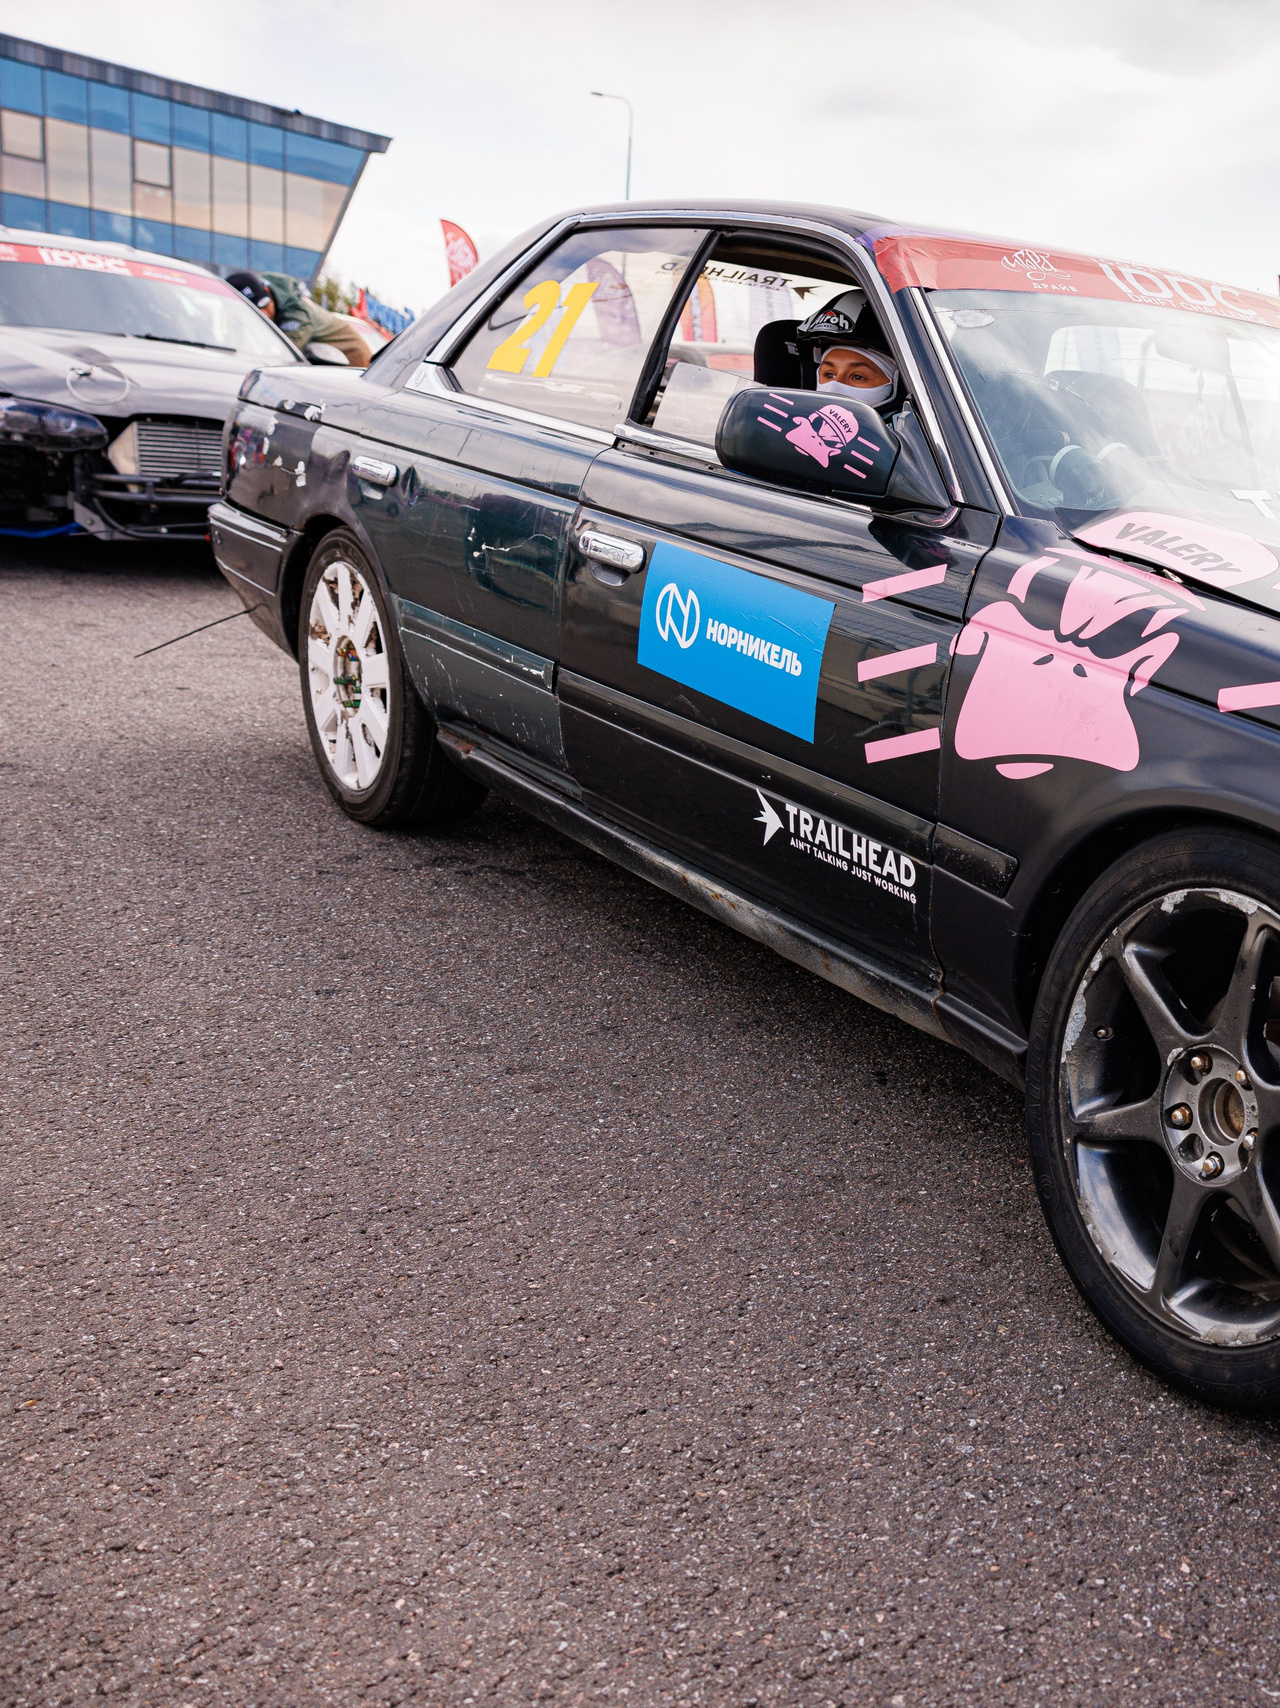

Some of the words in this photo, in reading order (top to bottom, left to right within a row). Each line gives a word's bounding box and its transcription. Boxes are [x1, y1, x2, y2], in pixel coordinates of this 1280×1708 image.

[1032, 282, 1078, 292] ДРАЙВ
[1100, 263, 1258, 316] IDDC
[1128, 293, 1178, 308] DRIFT
[1180, 301, 1271, 326] CHALLENGE
[486, 280, 600, 378] 21
[829, 408, 853, 434] VALERY
[1115, 523, 1242, 573] VALERY
[706, 618, 803, 677] НОРНИКЕЛЬ
[785, 803, 917, 888] TRAILHEAD
[790, 837, 811, 854] AIN'T
[813, 847, 849, 872] TALKING
[850, 864, 872, 883] JUST
[873, 875, 917, 905] WORKING
[1029, 1002, 1051, 1159] SAILUN
